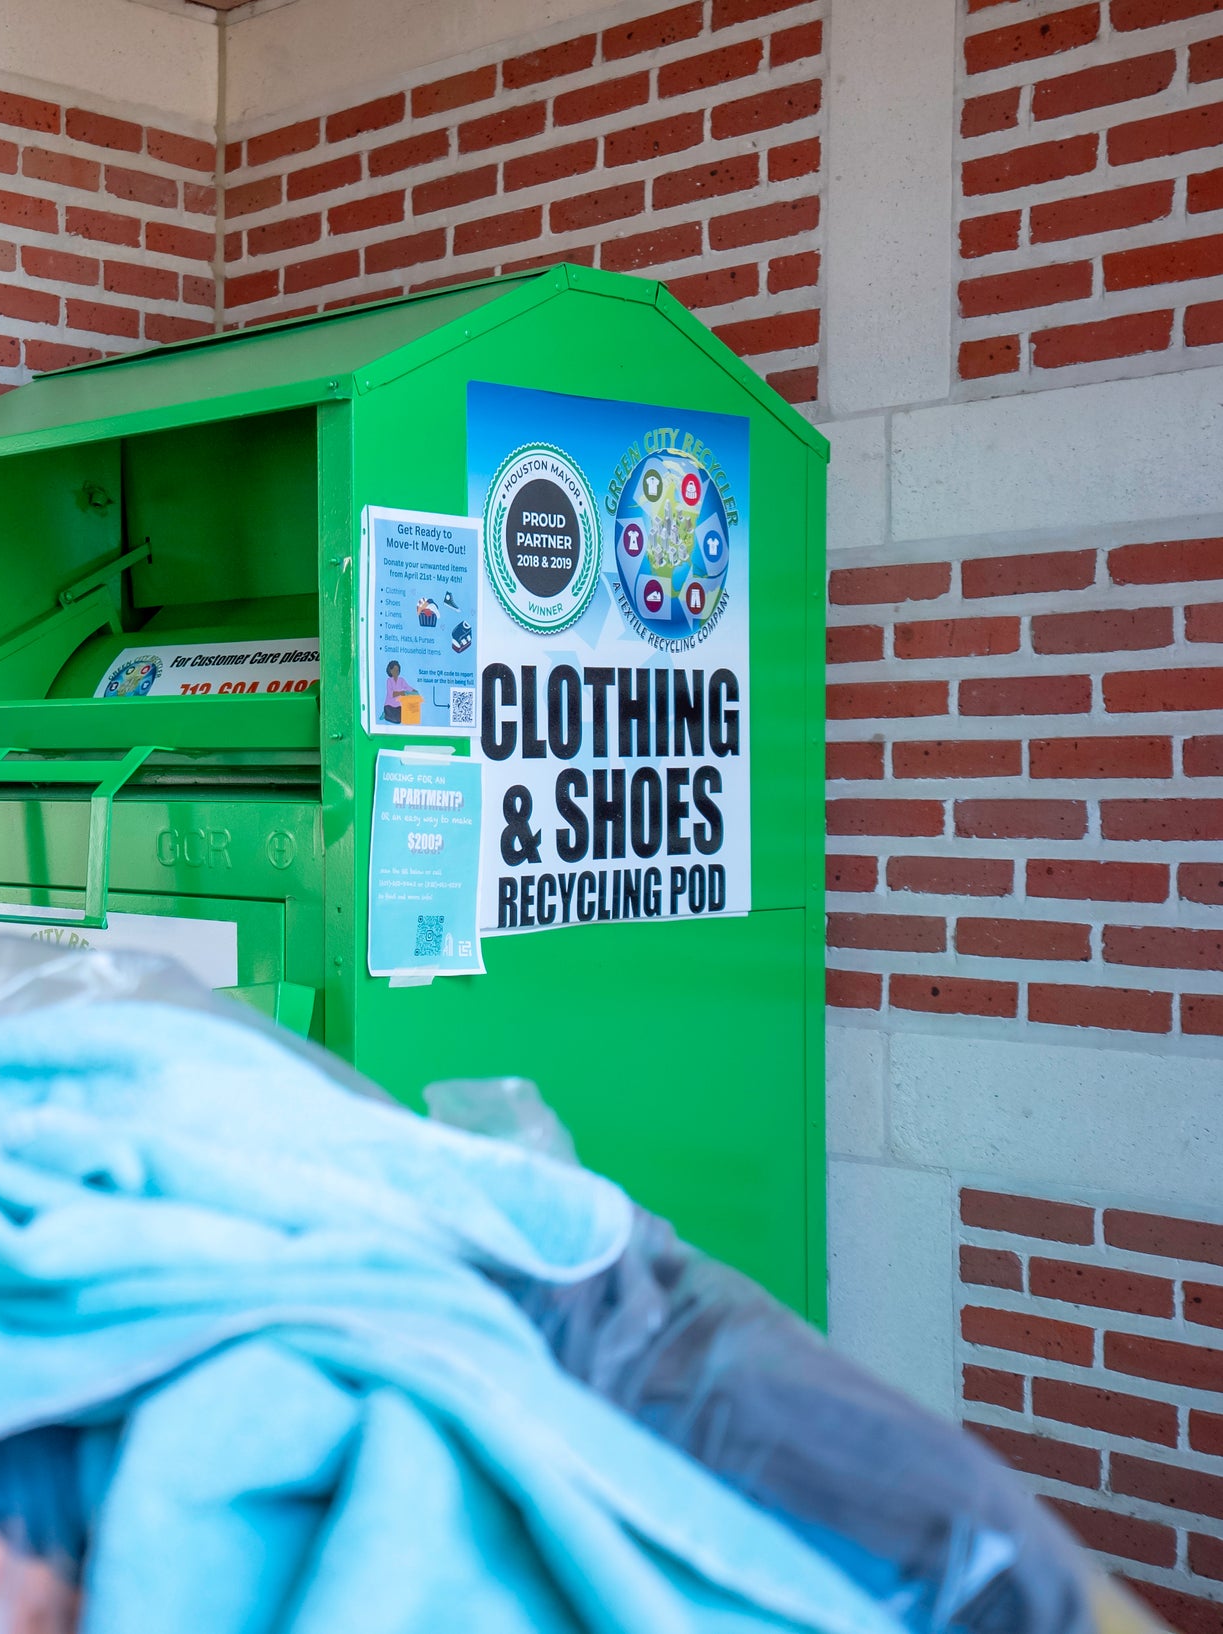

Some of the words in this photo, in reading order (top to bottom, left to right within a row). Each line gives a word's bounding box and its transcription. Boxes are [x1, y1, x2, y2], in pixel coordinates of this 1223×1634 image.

[504, 460, 548, 492] HOUSTON
[550, 463, 581, 499] MAYOR
[605, 441, 642, 516] GREEN
[644, 427, 680, 454] CITY
[682, 431, 739, 527] RECYCLER
[522, 511, 566, 529] PROUD
[397, 523, 413, 536] Get
[415, 525, 441, 540] Ready
[443, 530, 453, 539] to
[386, 537, 421, 551] Move-It
[421, 541, 466, 555] Move-Out!
[516, 532, 572, 550] PARTNER
[383, 557, 405, 568] Donate
[405, 561, 419, 569] your
[420, 562, 450, 572] unwanted
[450, 563, 467, 573] items
[516, 554, 540, 568] 2018
[541, 557, 549, 568] &
[550, 556, 572, 570] 2019
[389, 569, 404, 579] from
[404, 571, 419, 581] April
[419, 572, 432, 581] 21st
[436, 574, 449, 584] May
[450, 575, 463, 583] 4th!
[385, 586, 406, 597] Clothing
[385, 599, 401, 607] Shoes
[528, 601, 563, 617] WINNER
[385, 610, 402, 618] Linens
[612, 581, 621, 591] A
[618, 595, 648, 640] TEXTILE
[647, 633, 696, 654] RECYCLING
[697, 588, 730, 644] COMPANY
[385, 622, 403, 630] Towels
[384, 645, 399, 653] Small
[400, 647, 427, 655] Household
[169, 655, 192, 668] For
[190, 654, 250, 667] Customer
[249, 651, 281, 665] Care
[480, 662, 740, 762] CLOTHING
[382, 772, 414, 783] LOOKING
[417, 774, 433, 785] FOR
[435, 776, 446, 785] AN
[393, 787, 463, 808] APARTMENT?
[404, 815, 421, 827] easy
[440, 815, 449, 824] to
[500, 784, 542, 867] &
[555, 765, 724, 863] SHOES
[157, 828, 233, 869] GCR
[407, 832, 443, 851] $200?
[497, 866, 663, 929] RECYCLING
[670, 863, 726, 915] POD
